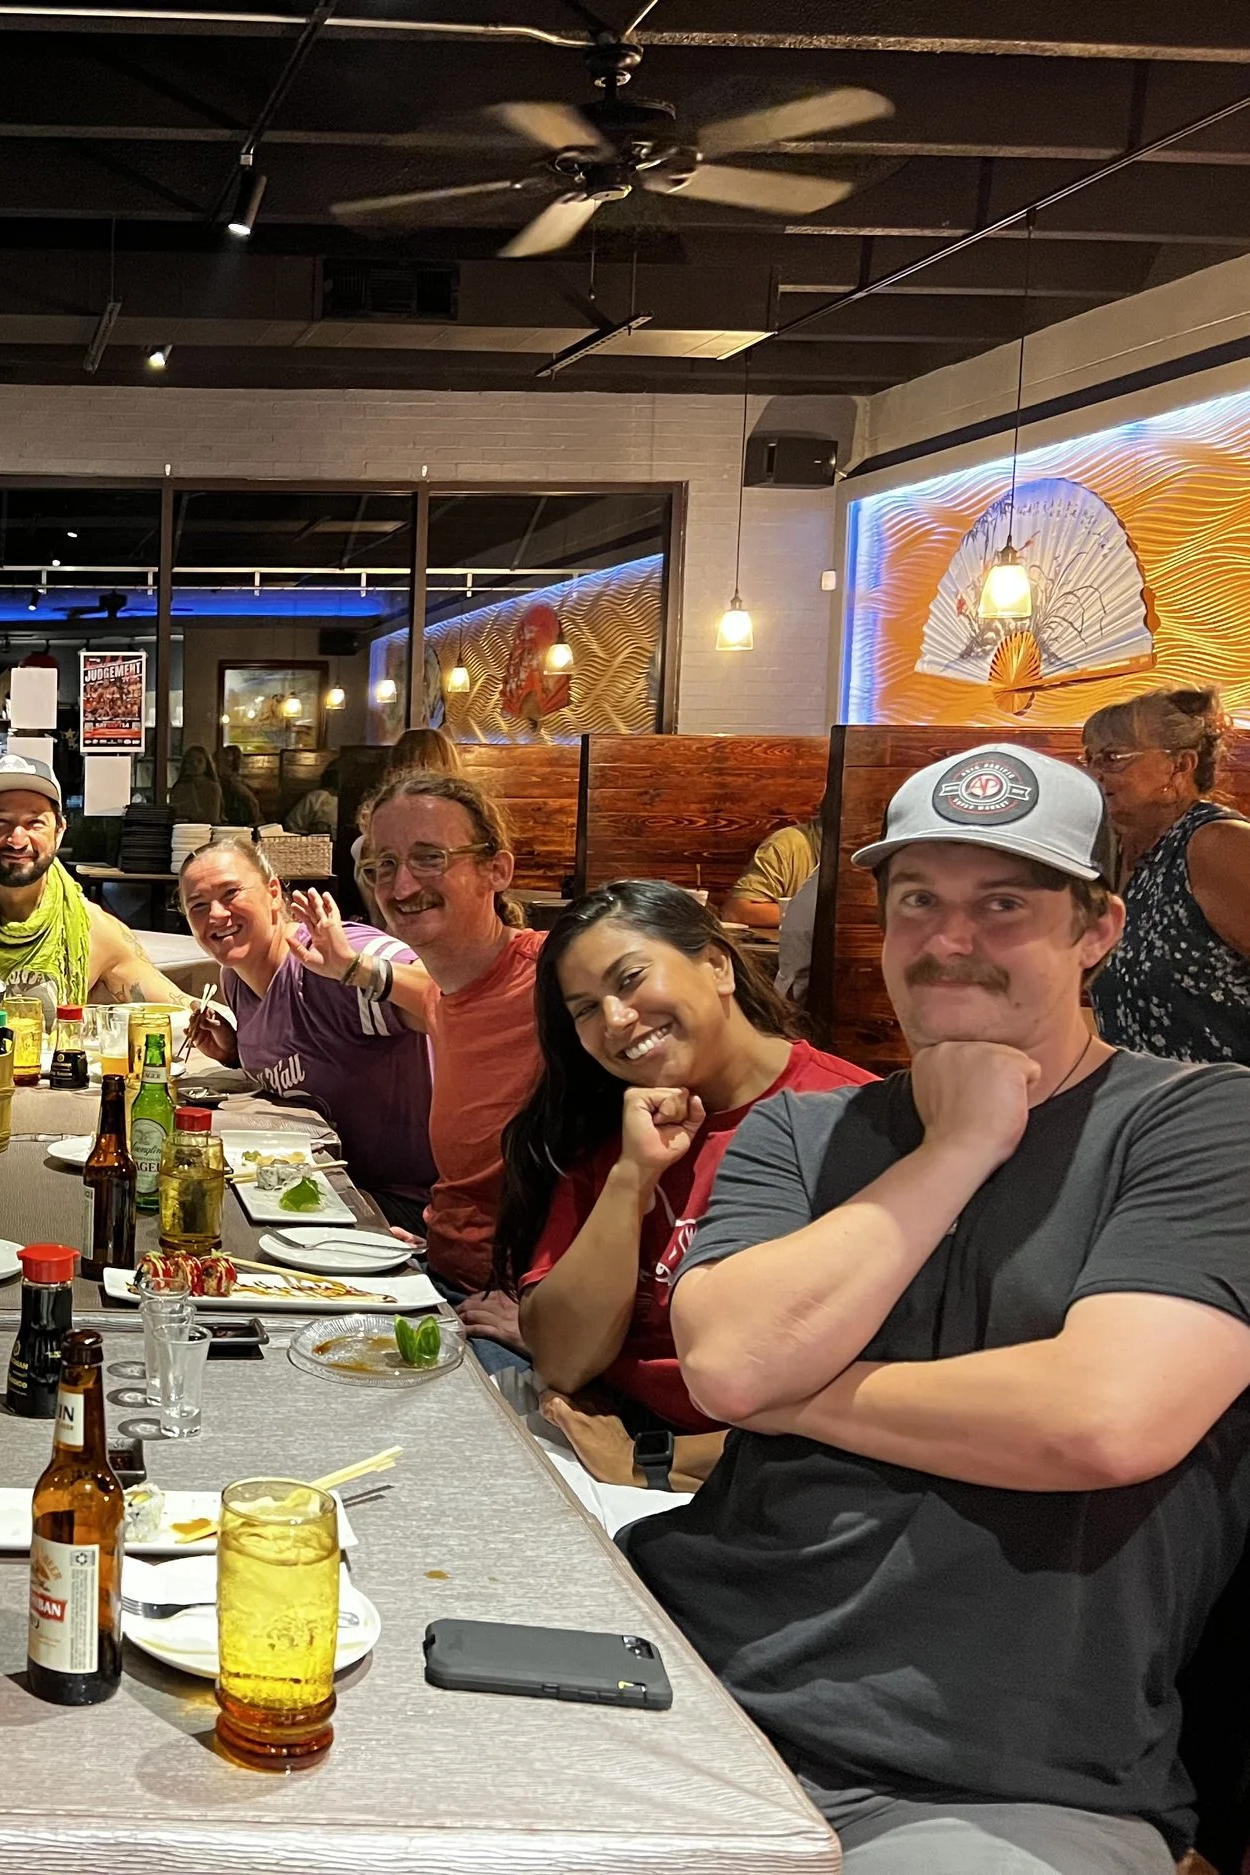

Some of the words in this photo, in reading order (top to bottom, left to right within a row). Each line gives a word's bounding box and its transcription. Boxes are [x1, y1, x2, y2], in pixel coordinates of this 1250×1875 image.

[85, 662, 141, 682] JUDGEMENT
[983, 763, 1016, 779] PACIFIC
[977, 800, 1010, 811] MARKET
[264, 1053, 306, 1098] Y'all
